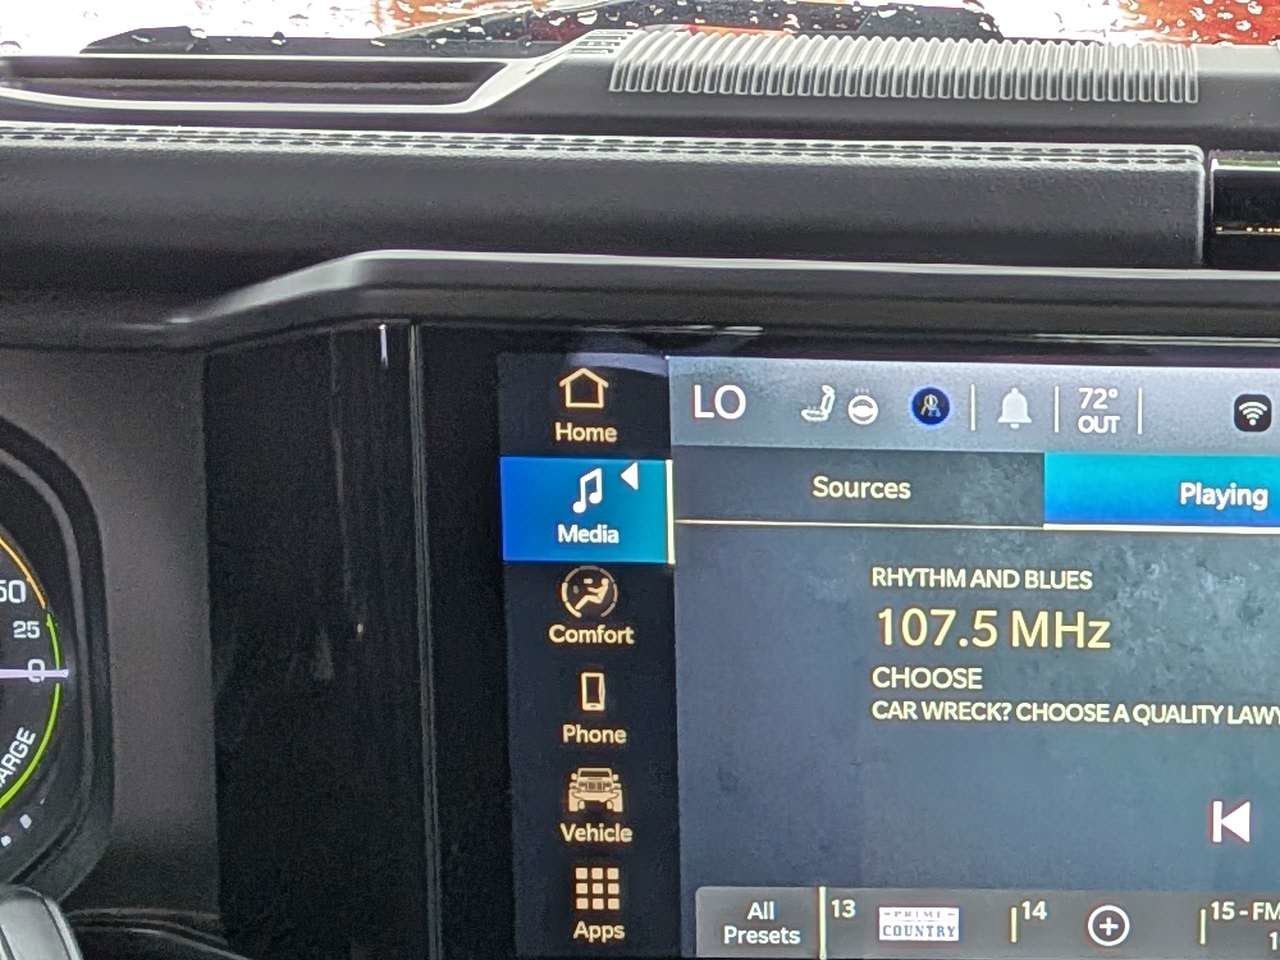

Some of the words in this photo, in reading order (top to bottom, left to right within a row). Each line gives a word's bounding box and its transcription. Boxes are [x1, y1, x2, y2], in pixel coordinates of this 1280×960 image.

[694, 385, 747, 419] LO
[1078, 386, 1119, 410] 72°
[555, 422, 617, 443] Home
[1077, 415, 1120, 434] OUT
[812, 476, 911, 500] Sources
[1180, 483, 1268, 511] Playing
[556, 524, 620, 545] Media
[872, 567, 966, 588] RHYTHM
[970, 569, 1020, 588] AND
[1024, 570, 1093, 590] BLUES
[13, 620, 40, 639] 25
[549, 624, 634, 644] Comfort
[878, 608, 998, 648] 107.5
[1012, 610, 1111, 649] MHz
[27, 658, 46, 683] 0
[872, 666, 983, 690] CHOOSE
[872, 700, 917, 720] CAR
[921, 701, 1012, 722] WRECK?
[1016, 702, 1110, 723] CHOOSE
[1112, 703, 1130, 723] A
[1132, 703, 1224, 727] QUALITY
[562, 725, 627, 744] Phone
[560, 823, 633, 843] Vehicle
[747, 900, 775, 920] All
[831, 899, 856, 918] 13
[1022, 900, 1048, 920] 14
[573, 921, 625, 943] Apps
[724, 925, 801, 945] Presets
[882, 923, 956, 938] COUNTRY
